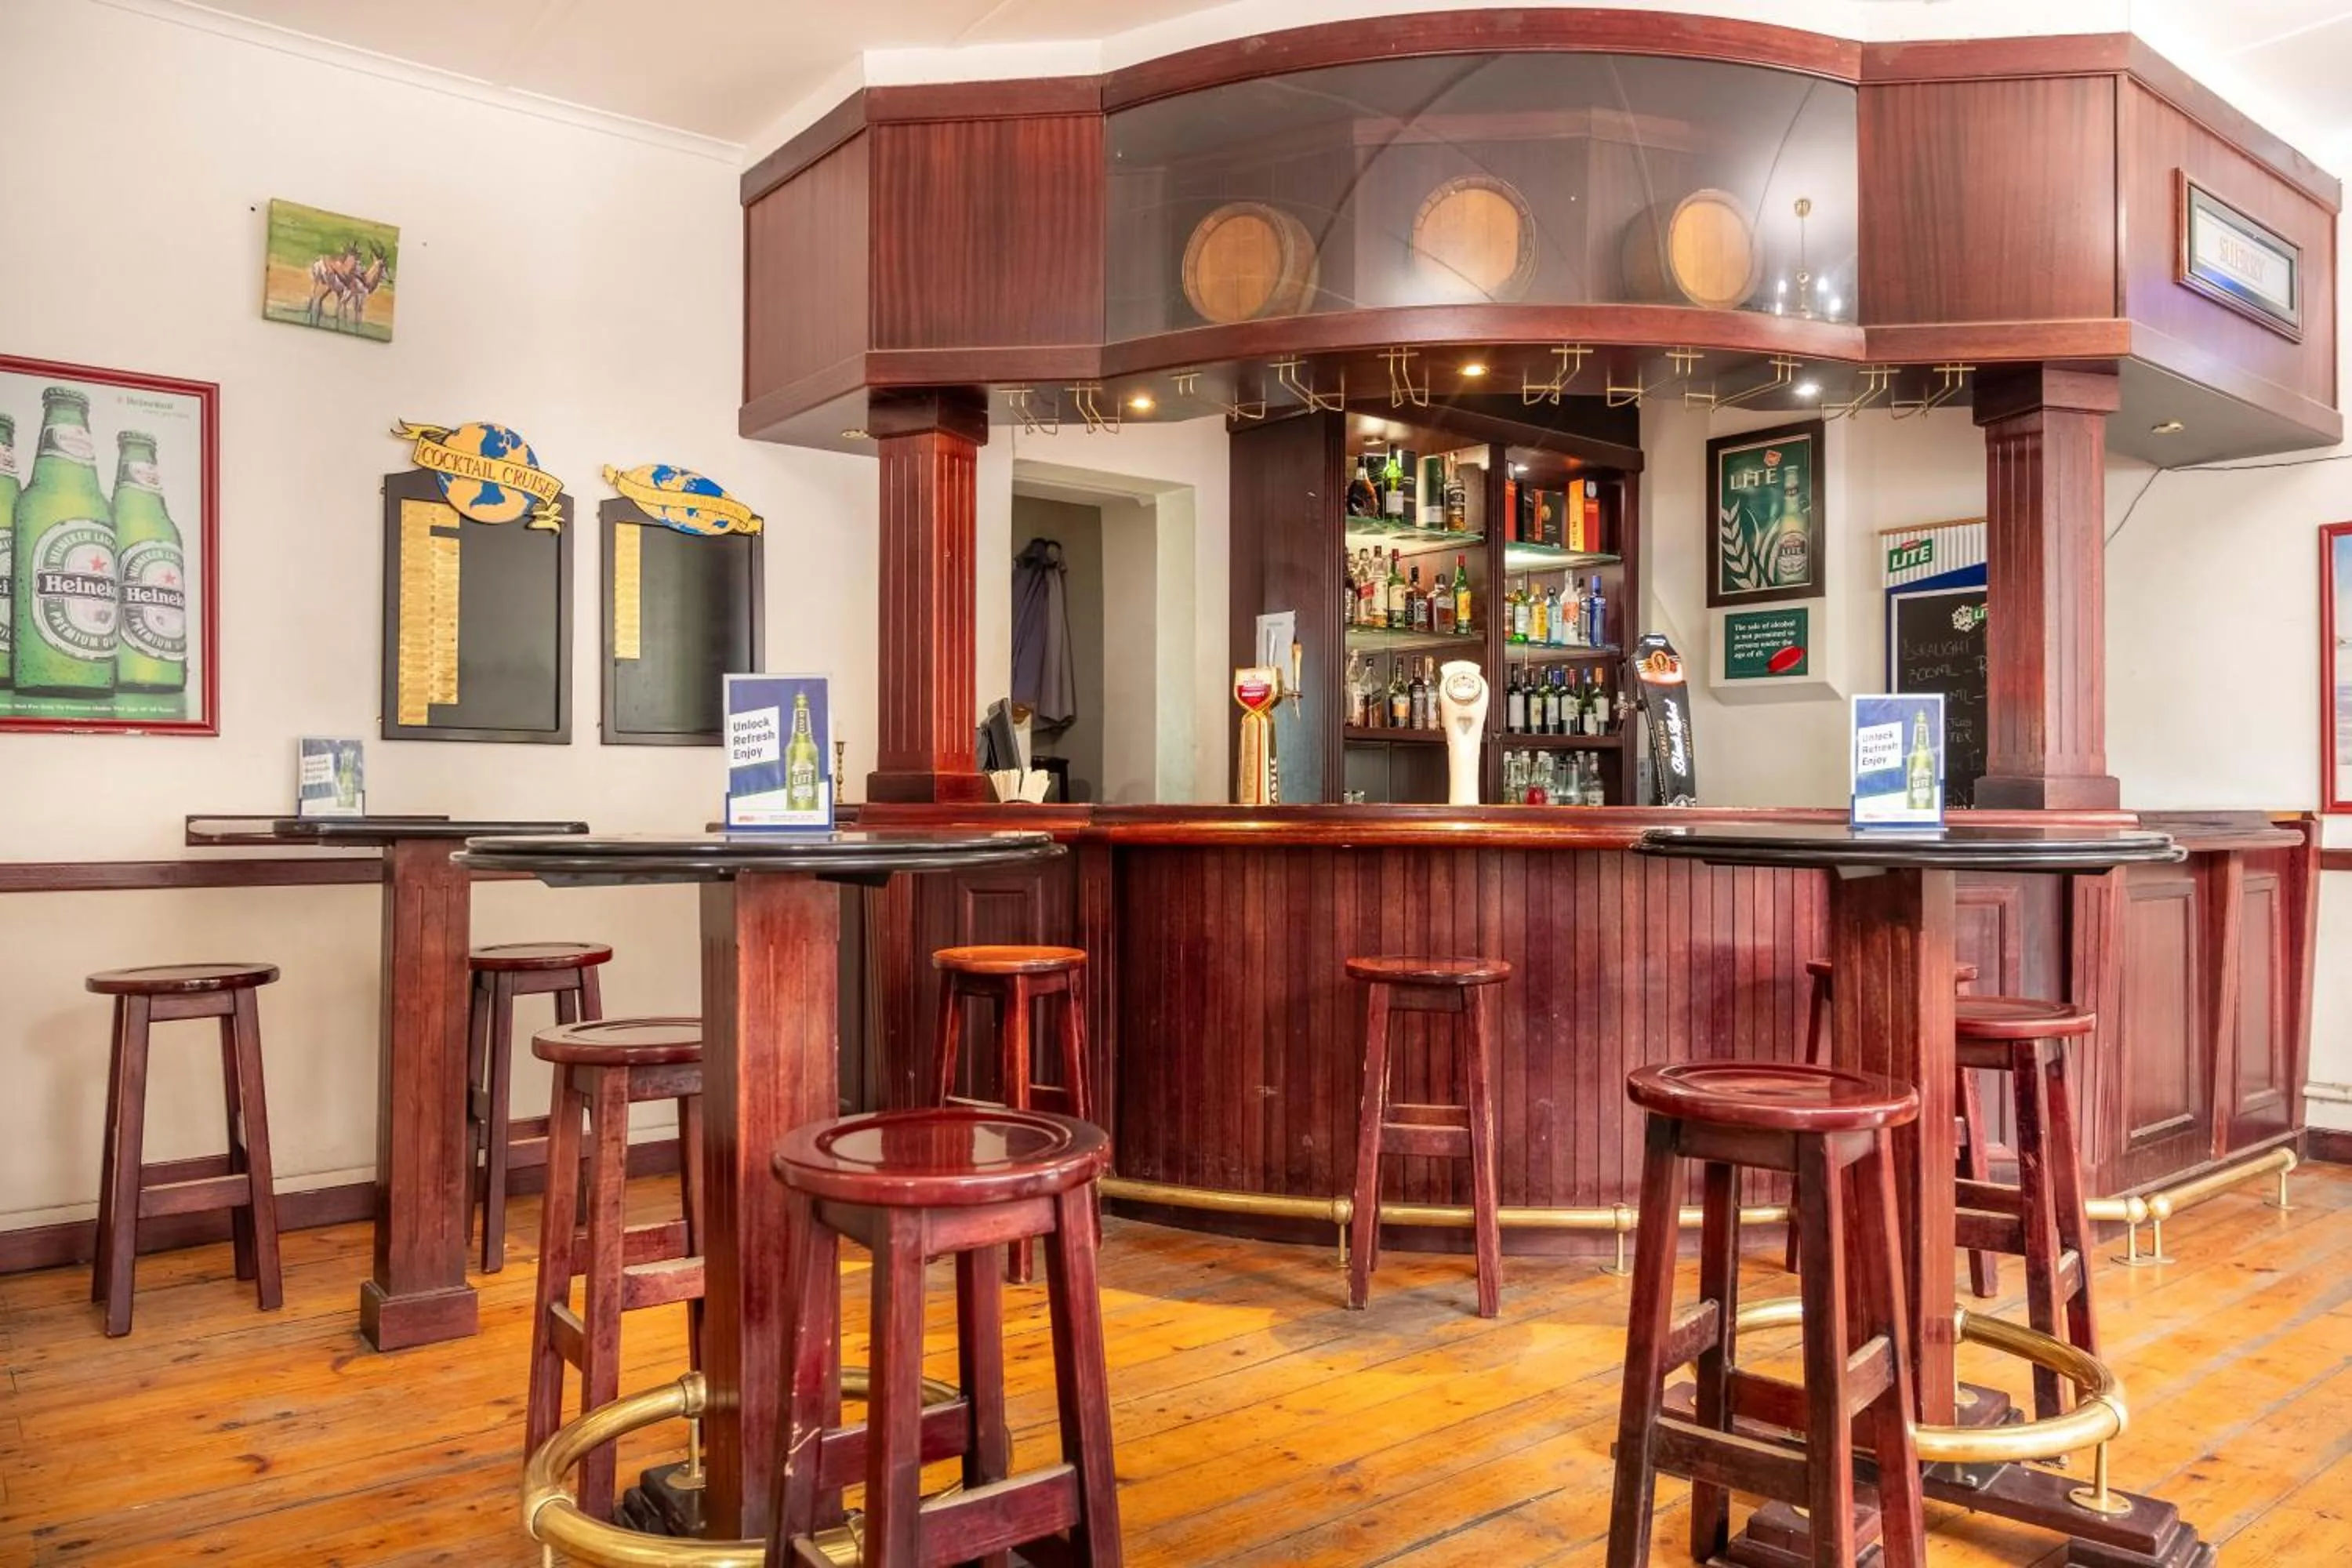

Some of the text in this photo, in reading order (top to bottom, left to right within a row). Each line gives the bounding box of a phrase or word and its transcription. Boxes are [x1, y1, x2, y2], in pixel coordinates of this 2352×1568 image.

[423, 446, 554, 496] COCKTAIL CRUISE
[1730, 467, 1780, 491] LITE
[1892, 545, 1931, 570] LITE
[733, 717, 771, 732] Unlock
[733, 730, 776, 745] Refresh
[1862, 730, 1893, 743] Unlock
[733, 746, 764, 760] Enjoy
[1862, 742, 1898, 754] Refresh
[1862, 756, 1887, 768] Enjoy
[1269, 757, 1278, 803] ASTLE
